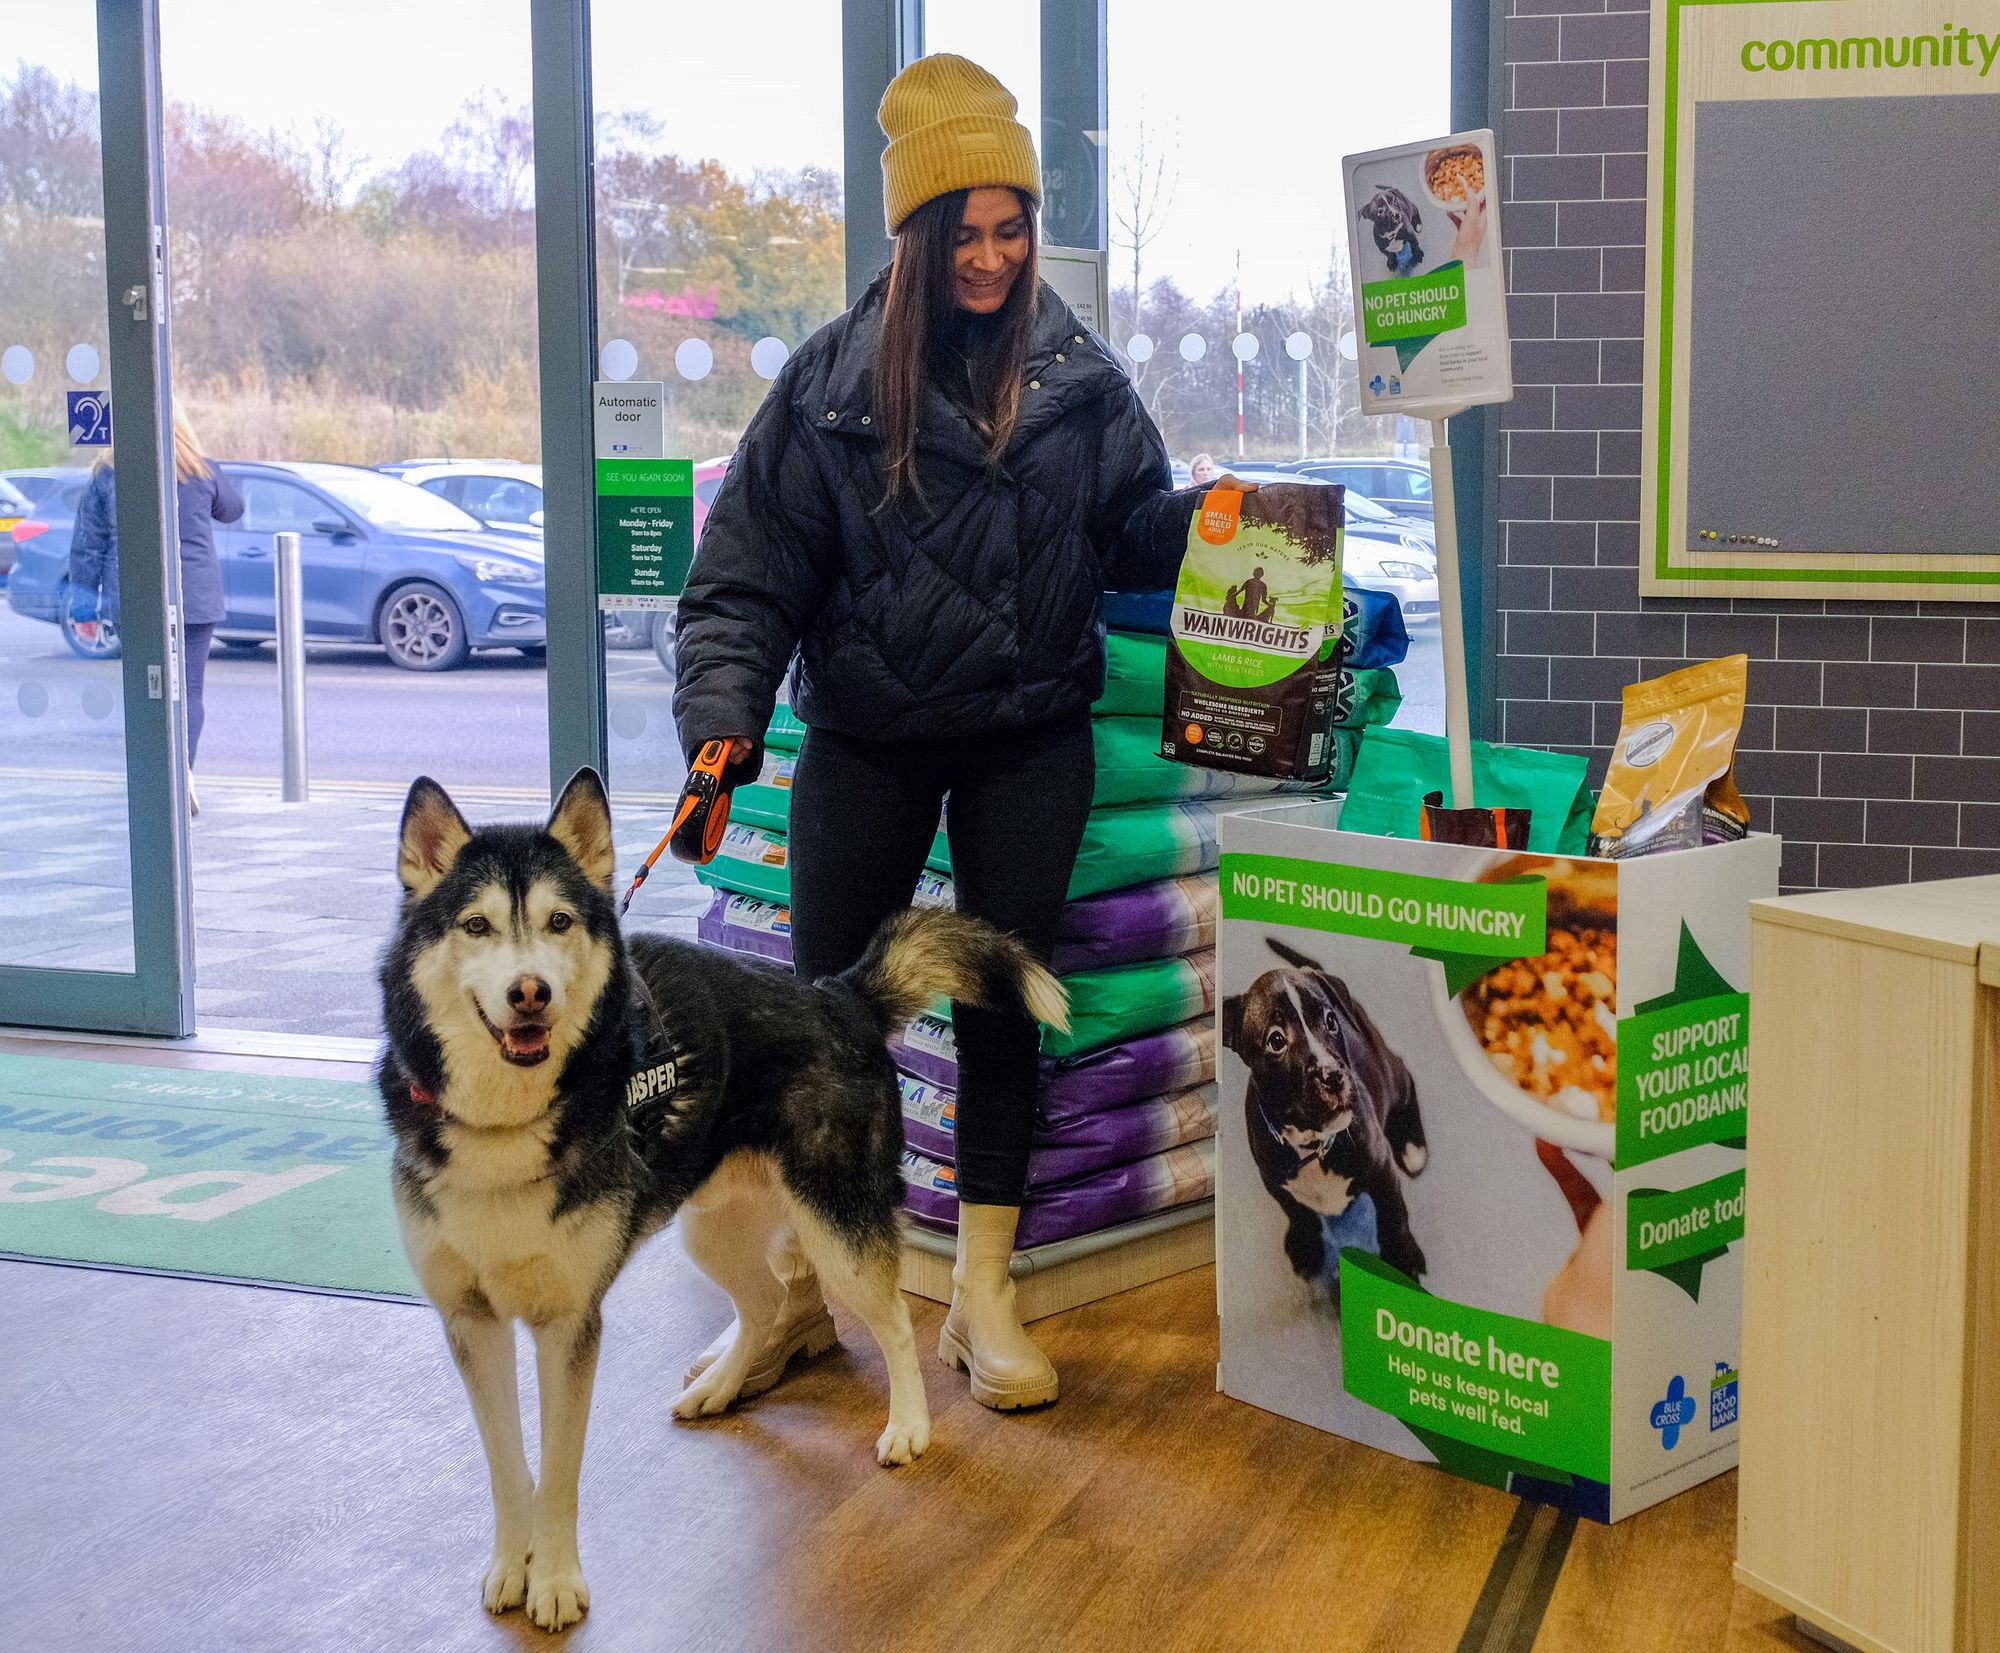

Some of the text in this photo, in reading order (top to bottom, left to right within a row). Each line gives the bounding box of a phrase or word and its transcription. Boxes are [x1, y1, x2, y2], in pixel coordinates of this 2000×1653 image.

[1741, 23, 2000, 77] community
[1365, 285, 1459, 311] NO PET SHOULD
[1376, 304, 1447, 327] GO HUNGRY
[599, 396, 657, 408] Automatic
[615, 411, 642, 422] door
[606, 472, 620, 482] SEE
[622, 473, 637, 482] YOU
[639, 473, 660, 482] AGAIN
[619, 519, 647, 529] Monday
[652, 519, 674, 529] Friday
[1204, 518, 1232, 529] BREED
[1205, 511, 1233, 522] SMALL
[631, 543, 662, 554] Saturday
[634, 568, 660, 579] Sunday
[1183, 611, 1310, 649] WAINWRIGHTS
[1212, 652, 1262, 668] LAMB & RICE
[1207, 662, 1264, 677] WITH VEGETABLES
[1194, 698, 1265, 716] WHOLESOME INGREDIENTS
[1191, 713, 1213, 721] ADDED
[1233, 871, 1526, 939] NO PET SHOULD GO HUNGRY
[1651, 1013, 1741, 1061] SUPPORT
[1635, 1063, 1690, 1101] YOUR
[1640, 1083, 1747, 1138] FOODBANK
[0, 1105, 264, 1158] hom
[0, 1148, 346, 1222] pe
[1640, 1186, 1745, 1251] Donate tod
[1376, 1308, 1559, 1388] Donate here
[1388, 1354, 1549, 1418] Help us keep local
[1712, 1386, 1728, 1403] PET
[1409, 1387, 1526, 1436] pets well fed.
[1664, 1401, 1682, 1414] BLUE
[1712, 1396, 1737, 1416] FOOD
[1655, 1413, 1680, 1427] CROSS
[1712, 1411, 1736, 1428] BANK
